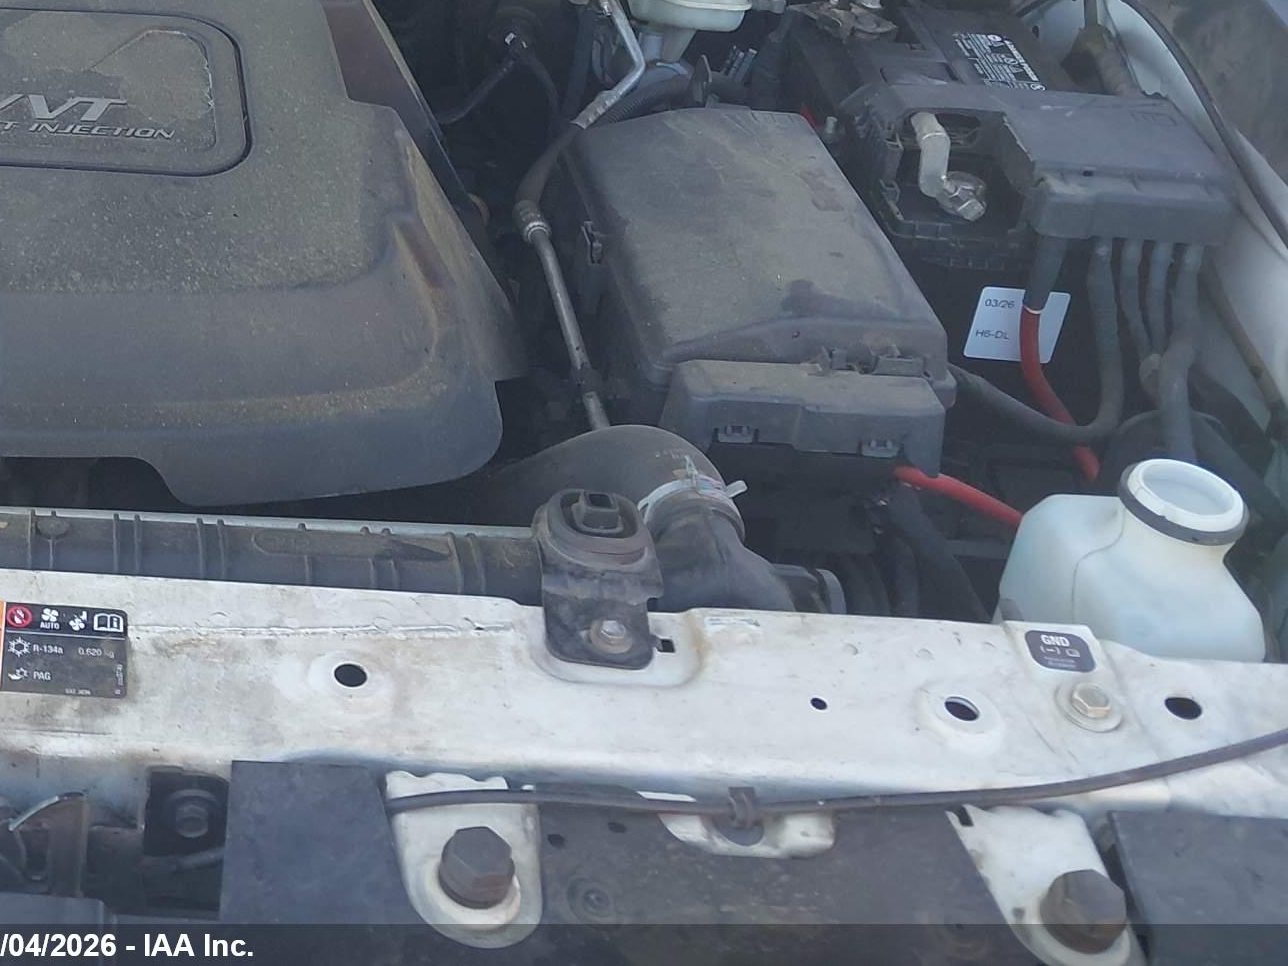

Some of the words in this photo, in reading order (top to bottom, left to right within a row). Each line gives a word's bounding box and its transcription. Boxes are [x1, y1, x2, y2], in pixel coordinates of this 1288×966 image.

[28, 121, 176, 140] INJECTION
[984, 299, 1015, 309] 03/26
[1040, 634, 1070, 647] GND
[32, 645, 63, 654] R-134a
[33, 670, 52, 681] PAG
